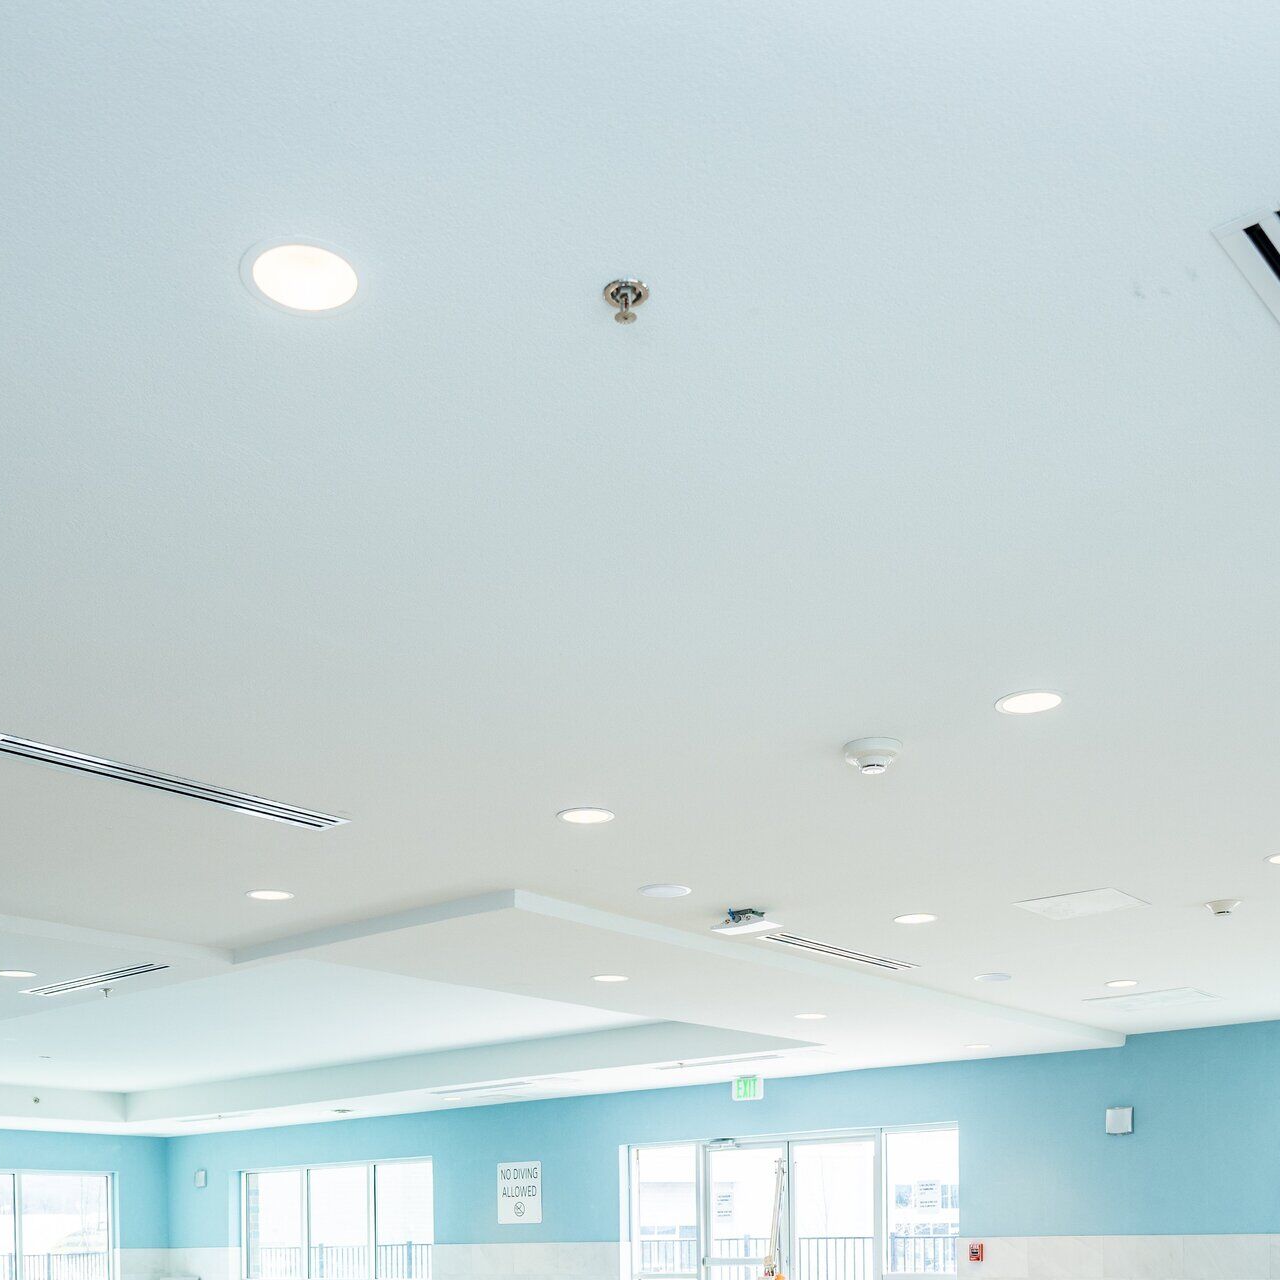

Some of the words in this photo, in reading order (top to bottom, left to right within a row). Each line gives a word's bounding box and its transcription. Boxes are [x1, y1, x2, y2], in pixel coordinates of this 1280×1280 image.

[737, 1079, 757, 1098] EXIT
[501, 1169, 511, 1180] NO
[514, 1168, 538, 1180] DIVING
[502, 1186, 537, 1198] ALLOWED
